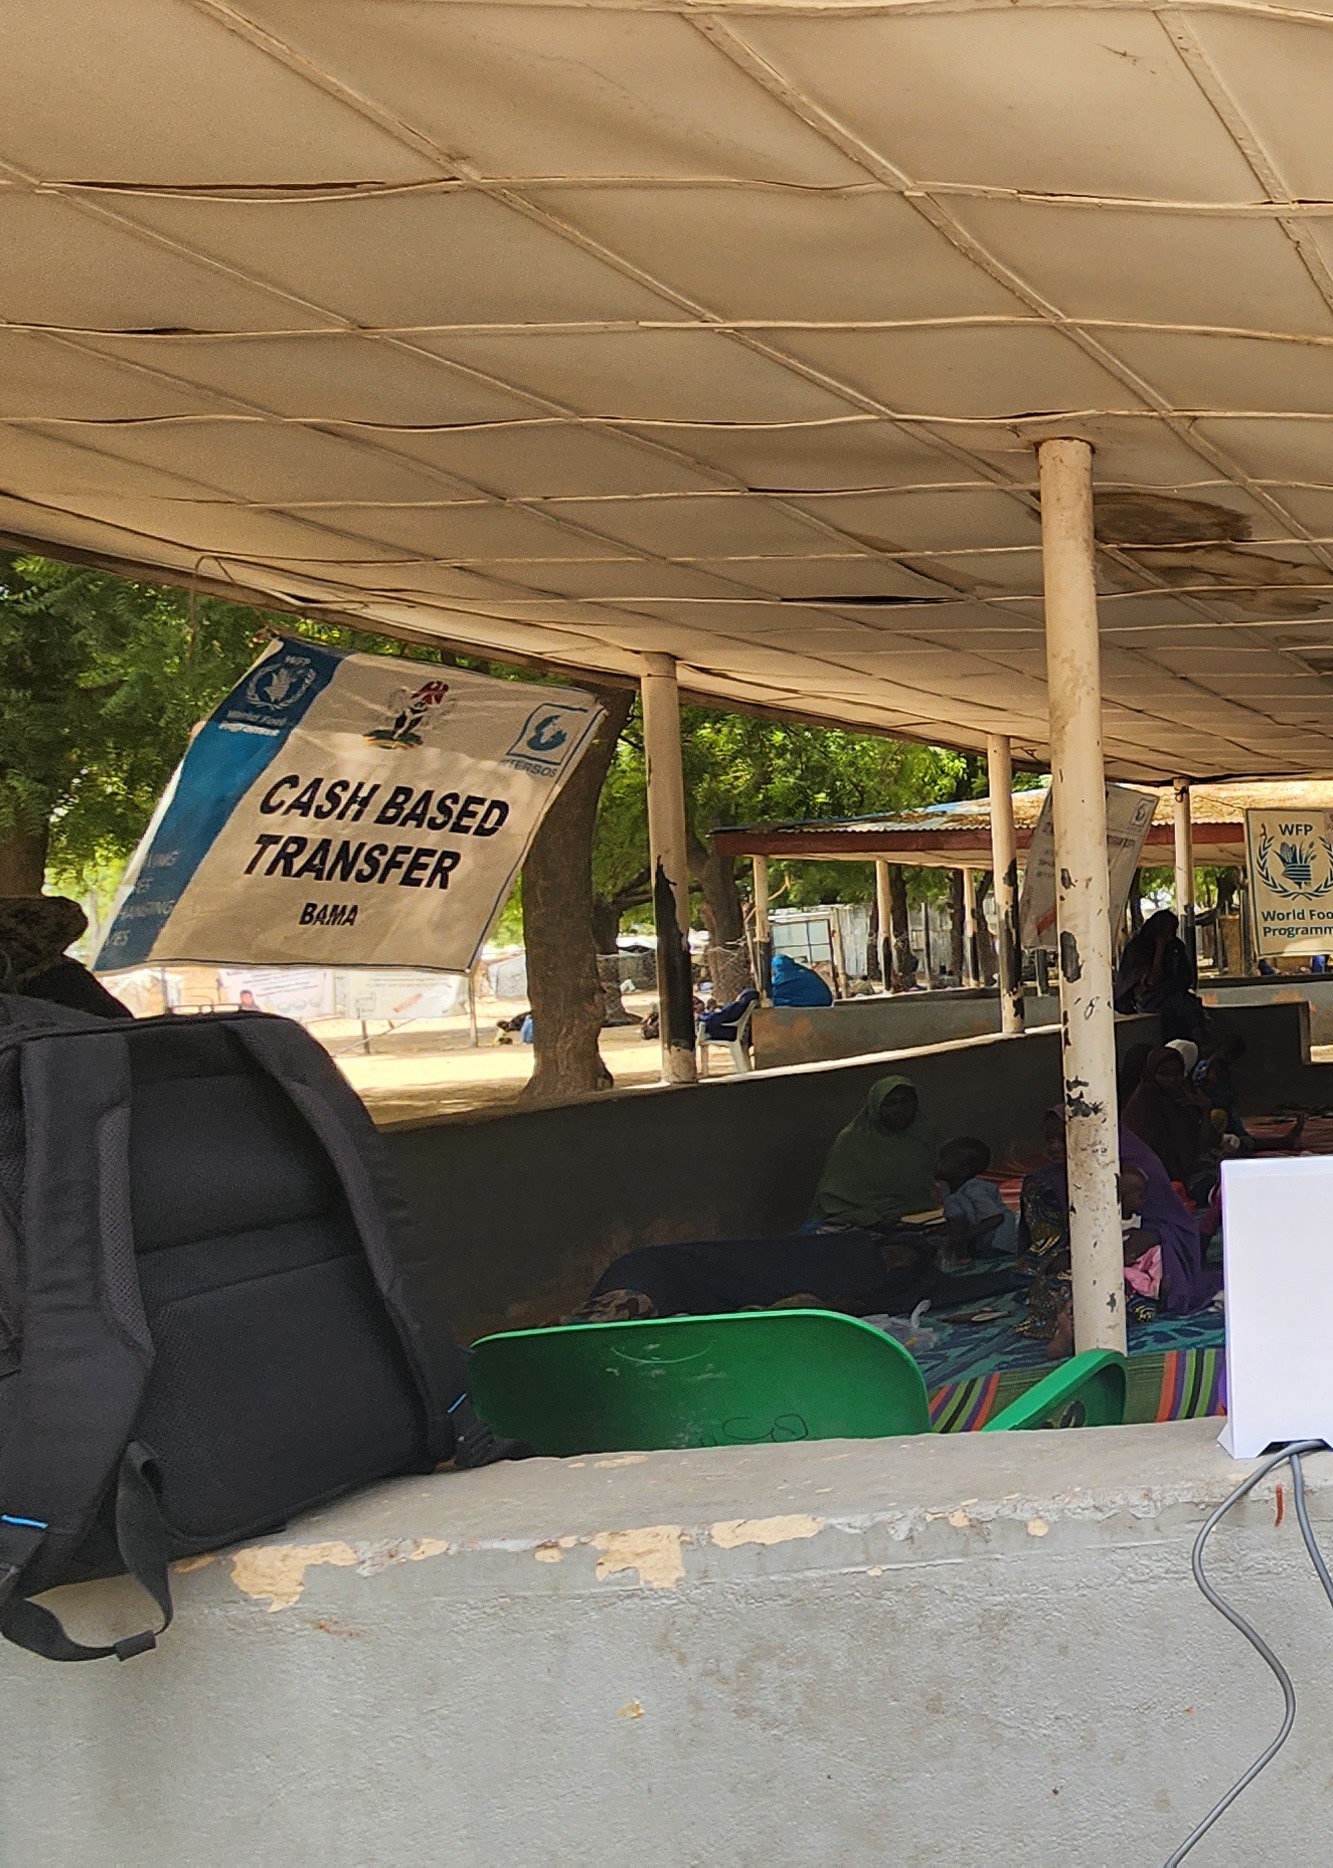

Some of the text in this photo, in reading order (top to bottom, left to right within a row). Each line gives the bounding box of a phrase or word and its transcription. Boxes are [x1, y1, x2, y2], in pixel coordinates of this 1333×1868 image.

[259, 774, 510, 837] CASH BASED
[1278, 823, 1314, 836] WFP
[244, 833, 462, 890] TRANSFER
[299, 902, 359, 926] BAMA
[1261, 909, 1306, 922] World
